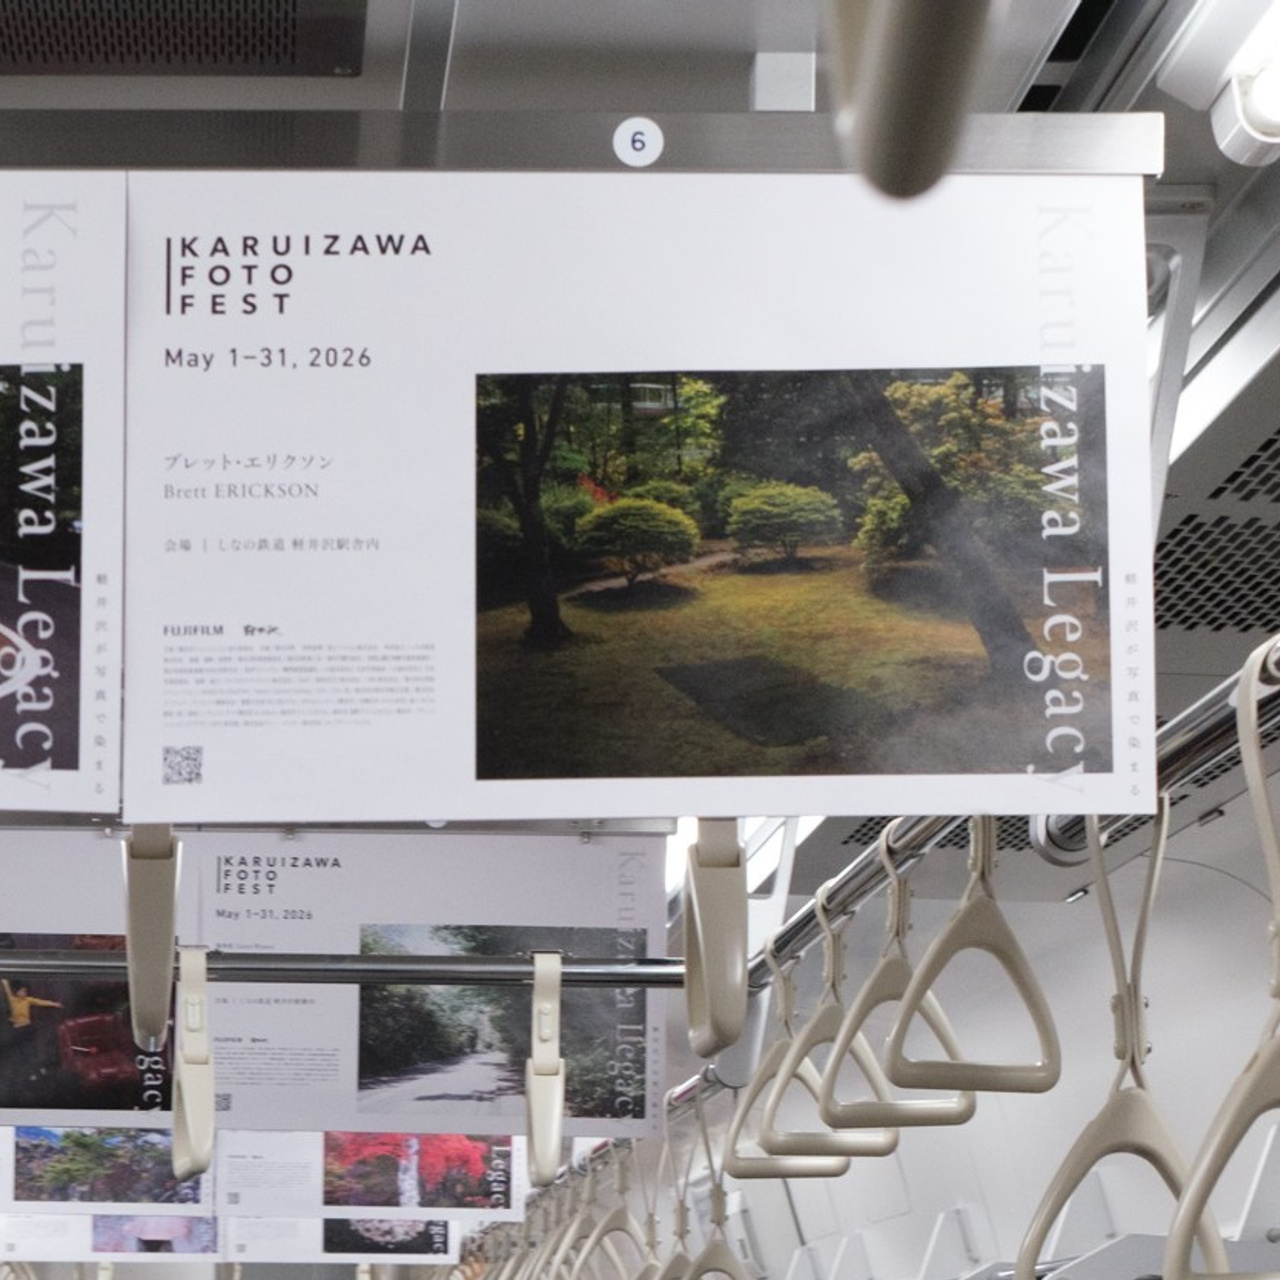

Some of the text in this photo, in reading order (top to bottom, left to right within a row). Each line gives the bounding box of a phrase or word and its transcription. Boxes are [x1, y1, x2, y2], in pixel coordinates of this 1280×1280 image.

[629, 130, 646, 152] 6
[179, 234, 432, 259] KARUIZAWA
[179, 263, 294, 287] FOTO
[179, 292, 291, 316] FEST
[19, 199, 79, 537] Karuizawa
[164, 348, 215, 373] May
[308, 346, 373, 369] 2026
[163, 482, 320, 500] Brett ERICKSON
[1023, 203, 1103, 795] Karuizawa Legacy
[163, 624, 225, 637] FUJIFILM
[223, 855, 342, 869] KARUIZAWA
[223, 869, 278, 882] FOTO
[223, 882, 276, 895] FEST
[215, 908, 241, 922] May
[282, 908, 314, 921] 2026
